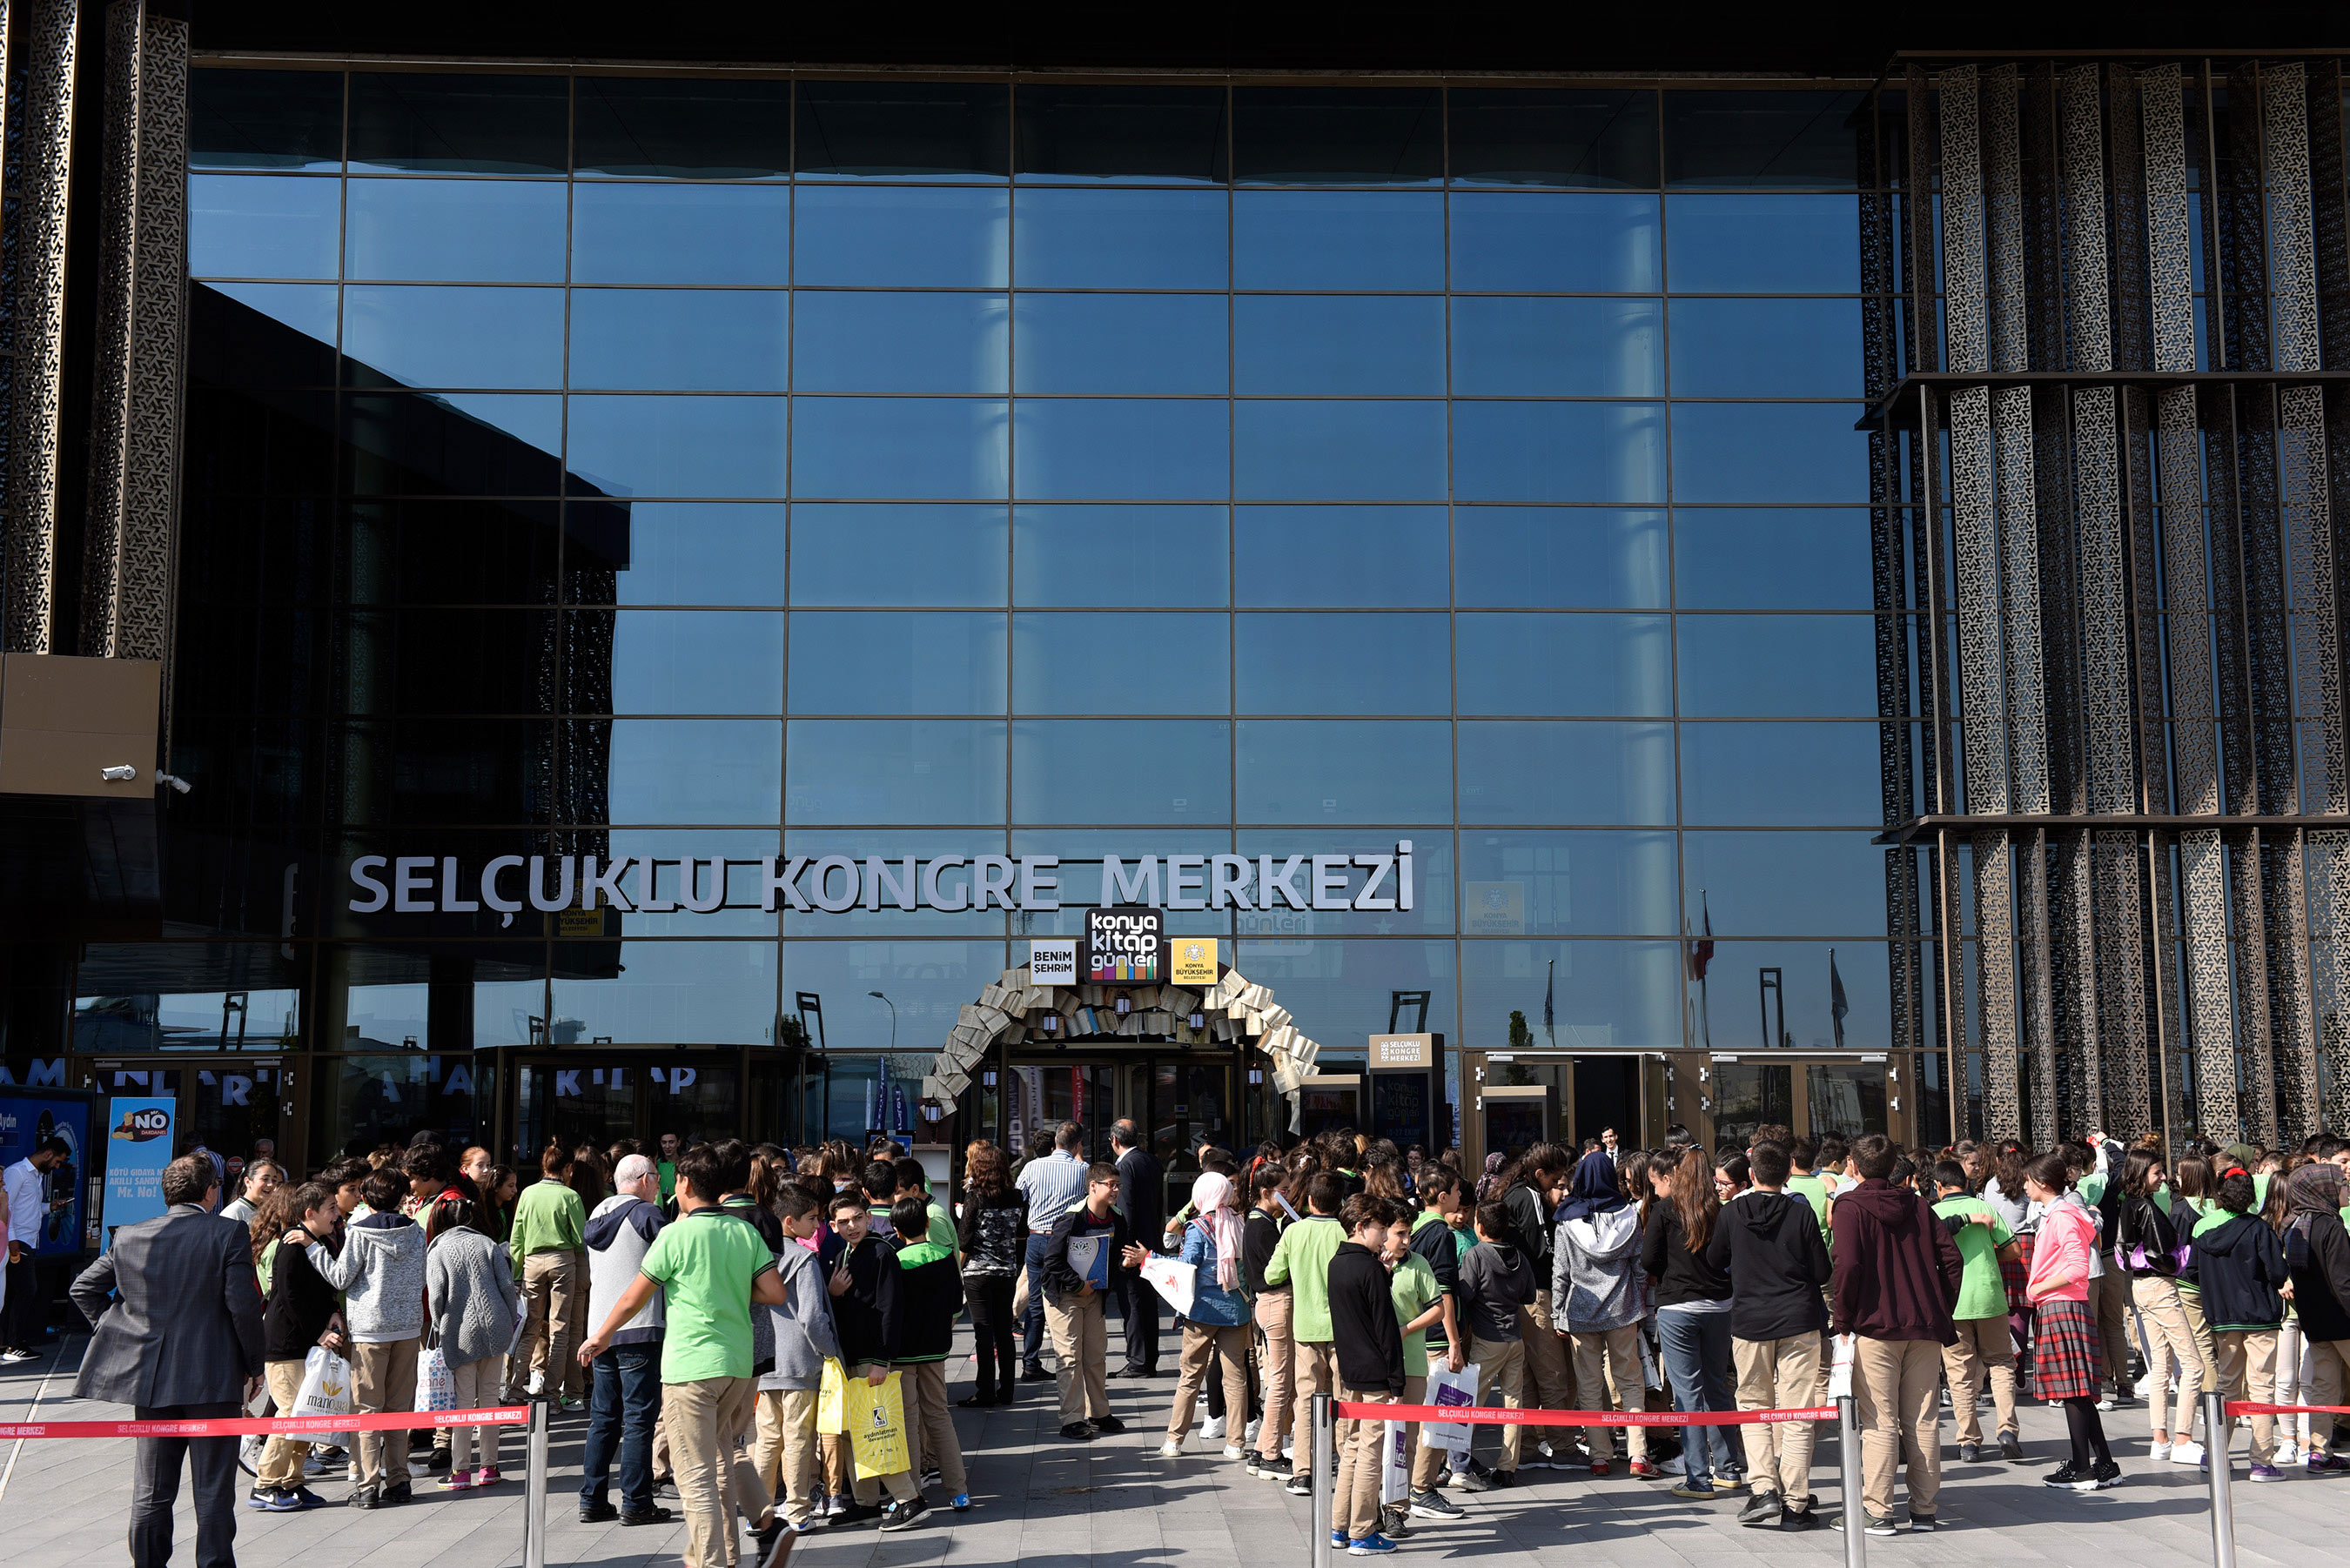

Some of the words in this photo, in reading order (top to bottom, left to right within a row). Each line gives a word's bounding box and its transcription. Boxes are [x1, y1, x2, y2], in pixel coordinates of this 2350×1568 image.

[349, 854, 726, 928] SELÇUKLU
[762, 854, 1059, 912] KONGRE
[1100, 840, 1413, 911] MERKEZİ
[1091, 912, 1158, 935] konya
[1091, 930, 1158, 955] kitap
[1091, 952, 1158, 971] günleri
[135, 1114, 167, 1129] NO
[109, 1168, 129, 1176] KÖTÜ
[118, 1186, 134, 1197] Mr.
[138, 1186, 158, 1197] No!
[434, 1413, 467, 1425] SELÇUKLU
[467, 1411, 494, 1422] KONGRE
[494, 1410, 522, 1421] MERKEZİ
[1438, 1409, 1470, 1420] SELÇUKLU
[1470, 1410, 1496, 1419] KONGRE
[1497, 1410, 1524, 1420] MERKEZİ
[1601, 1414, 1634, 1424] SELÇUKLU
[1635, 1415, 1660, 1424] KONGRE
[1661, 1414, 1689, 1424] MERKEZİ
[1759, 1412, 1791, 1423] SELÇUKLU
[1792, 1411, 1819, 1420] KONGRE
[17, 1424, 45, 1435] MERKEZİ
[118, 1424, 151, 1434] SELÇUKLU
[151, 1424, 178, 1433] KONGRE
[178, 1424, 207, 1432] MERKEZİ
[272, 1420, 305, 1431] SELÇUKLU
[305, 1419, 332, 1430] KONGRE
[332, 1417, 360, 1428] MERKEZİ
